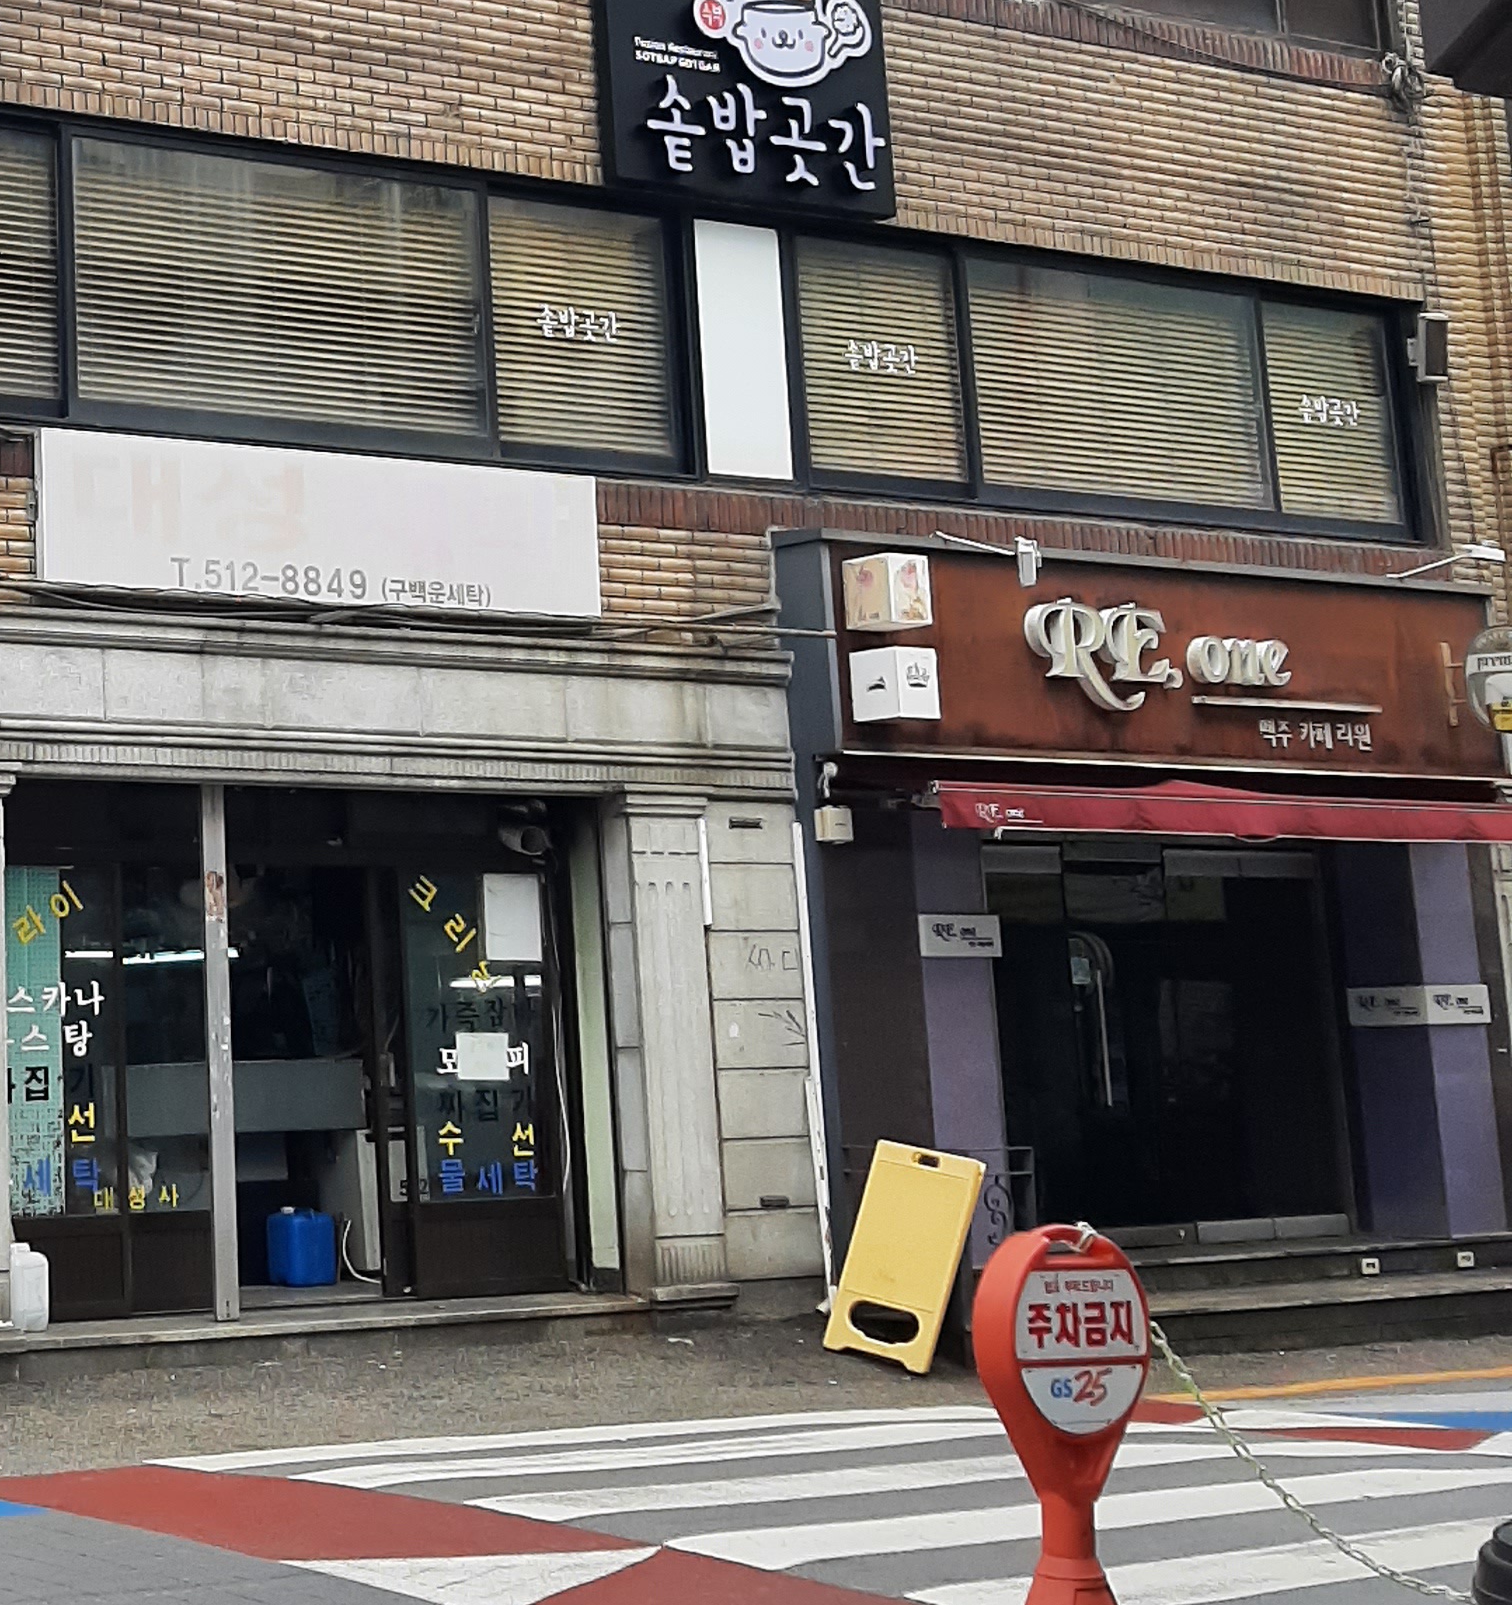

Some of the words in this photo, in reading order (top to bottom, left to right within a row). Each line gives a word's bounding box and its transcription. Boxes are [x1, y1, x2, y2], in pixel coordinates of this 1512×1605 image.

[646, 74, 886, 190] 솥밥곳간
[536, 303, 621, 342] 솥밥곳간
[844, 339, 919, 374] 솥밥곳간
[1298, 393, 1361, 427] 솥밥곳간
[170, 557, 368, 601] T.512-8849
[1259, 718, 1293, 748] 맥주
[6, 1020, 94, 1058] 스탕
[1028, 1300, 1134, 1349] 주차금지
